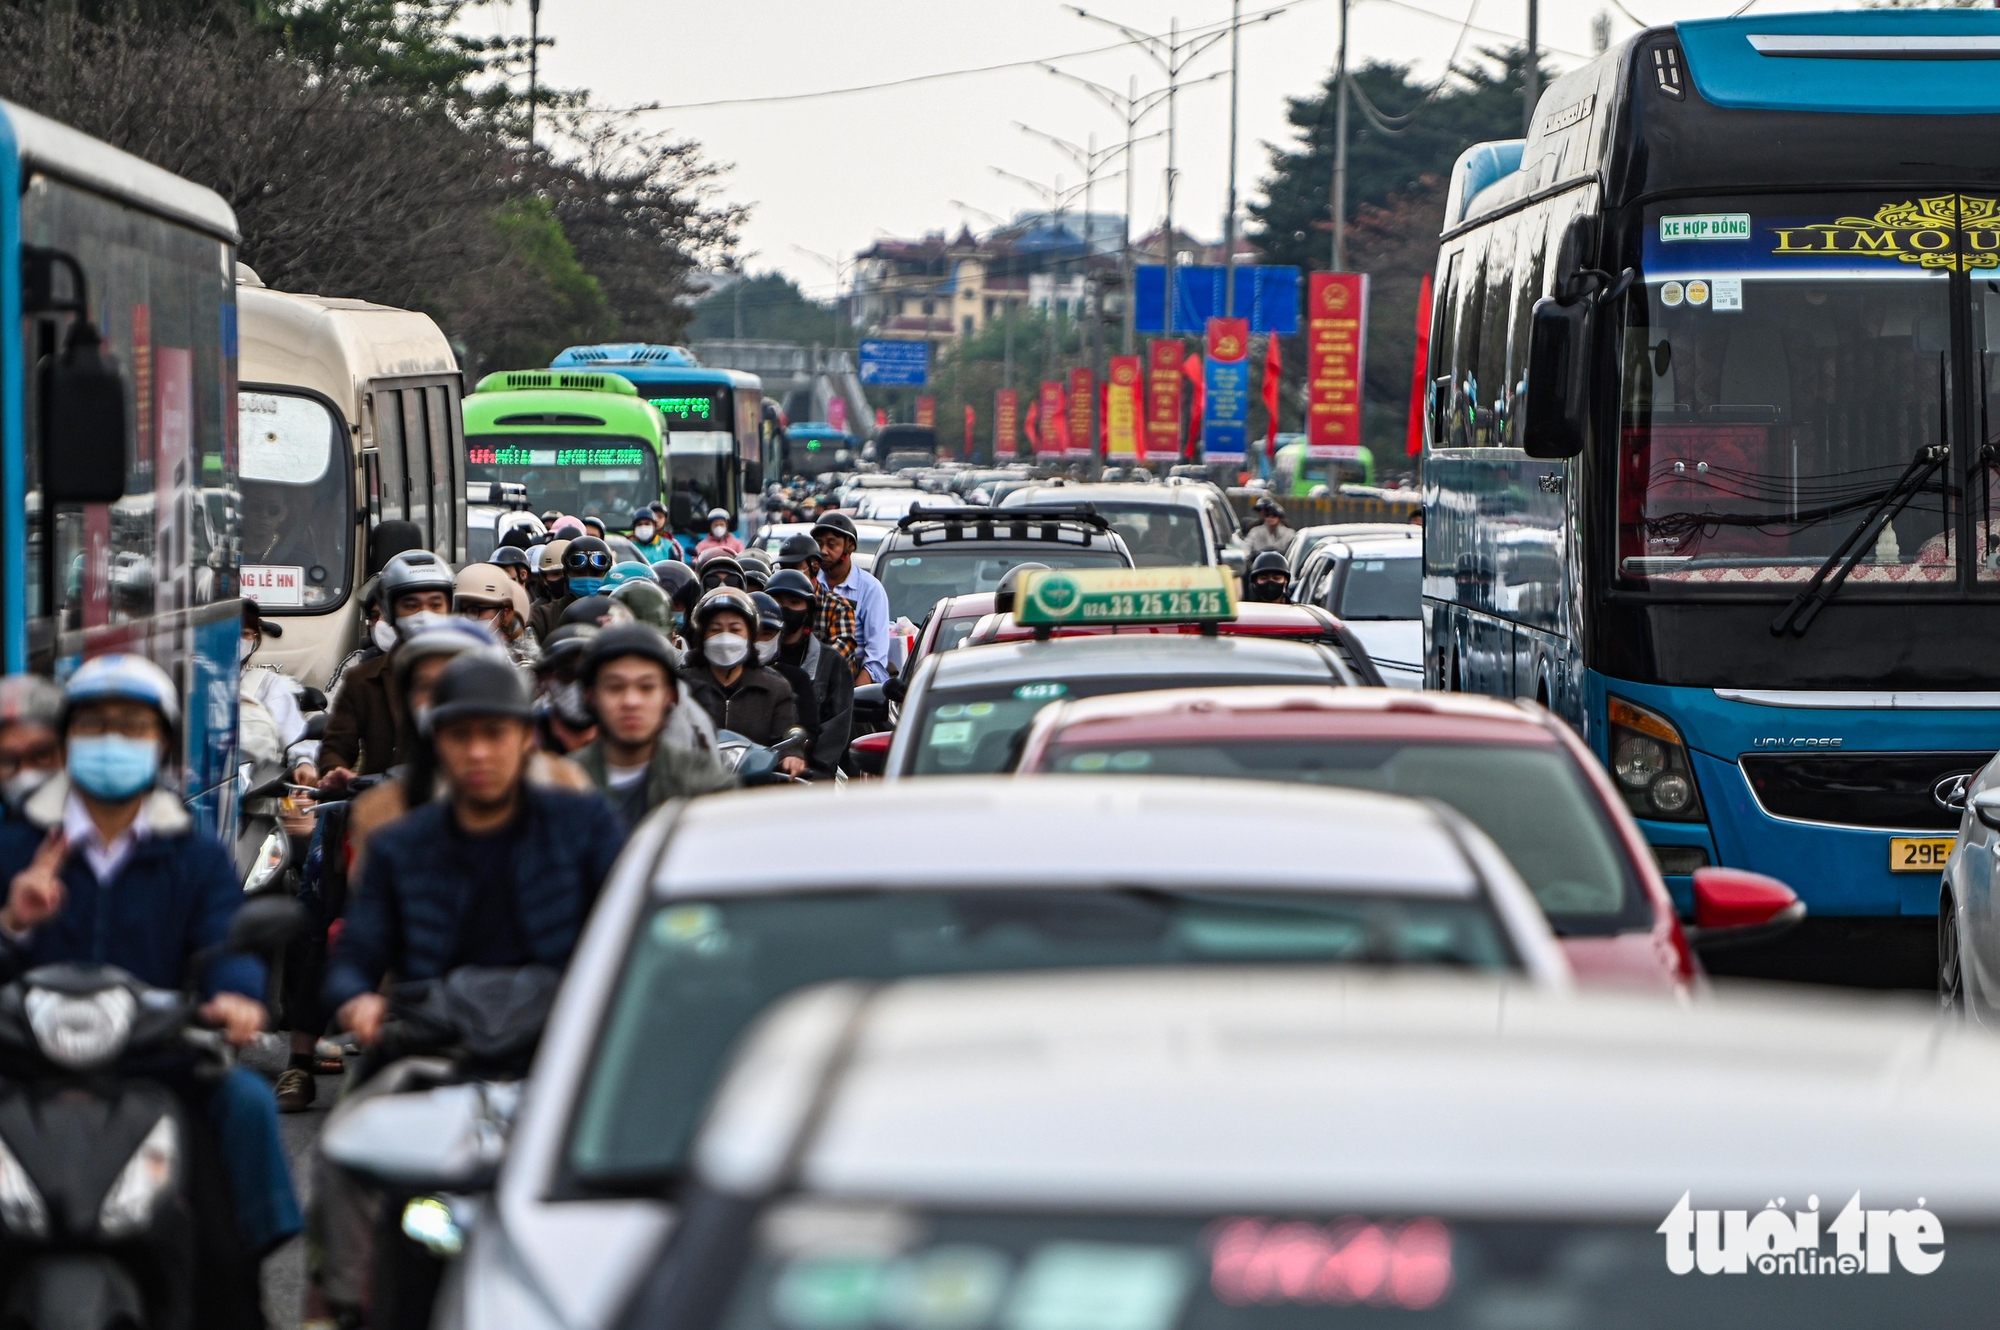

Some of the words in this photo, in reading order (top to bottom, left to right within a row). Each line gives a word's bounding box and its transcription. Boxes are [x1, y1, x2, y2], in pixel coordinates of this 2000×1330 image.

[1664, 222, 1680, 236] XE
[1683, 220, 1708, 237] HỢP
[258, 569, 273, 587] LỄ
[276, 573, 294, 587] HN
[1753, 737, 1843, 748] UNIVERSE
